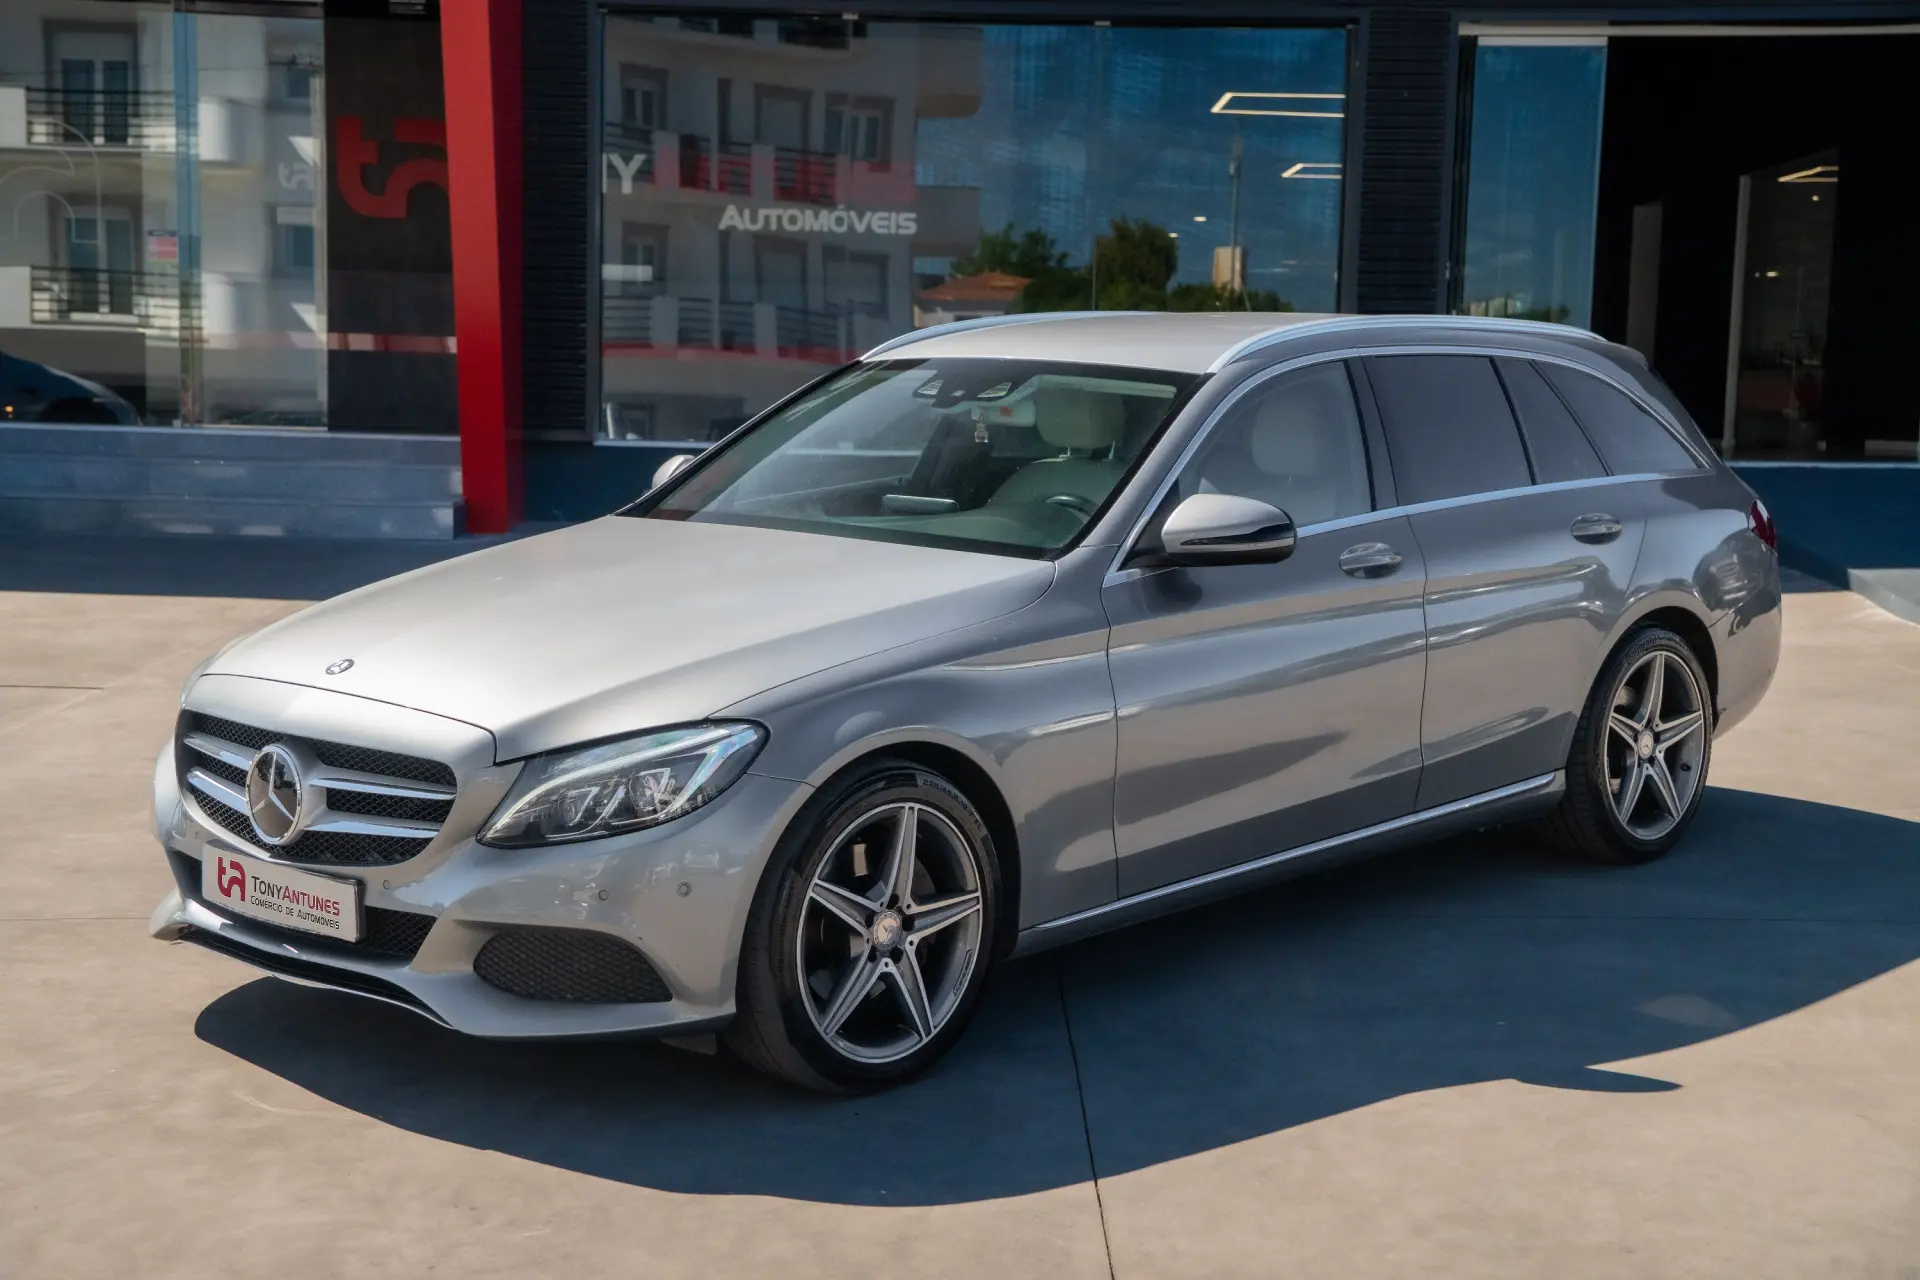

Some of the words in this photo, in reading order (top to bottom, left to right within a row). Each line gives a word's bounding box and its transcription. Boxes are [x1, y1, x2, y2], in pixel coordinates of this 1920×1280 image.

[602, 152, 649, 195] Y
[718, 204, 918, 235] AUTOMÓVEIS
[250, 895, 283, 914] COMÉRCIO
[285, 906, 295, 917] DE
[297, 909, 340, 930] AUTOMÓVEIS
